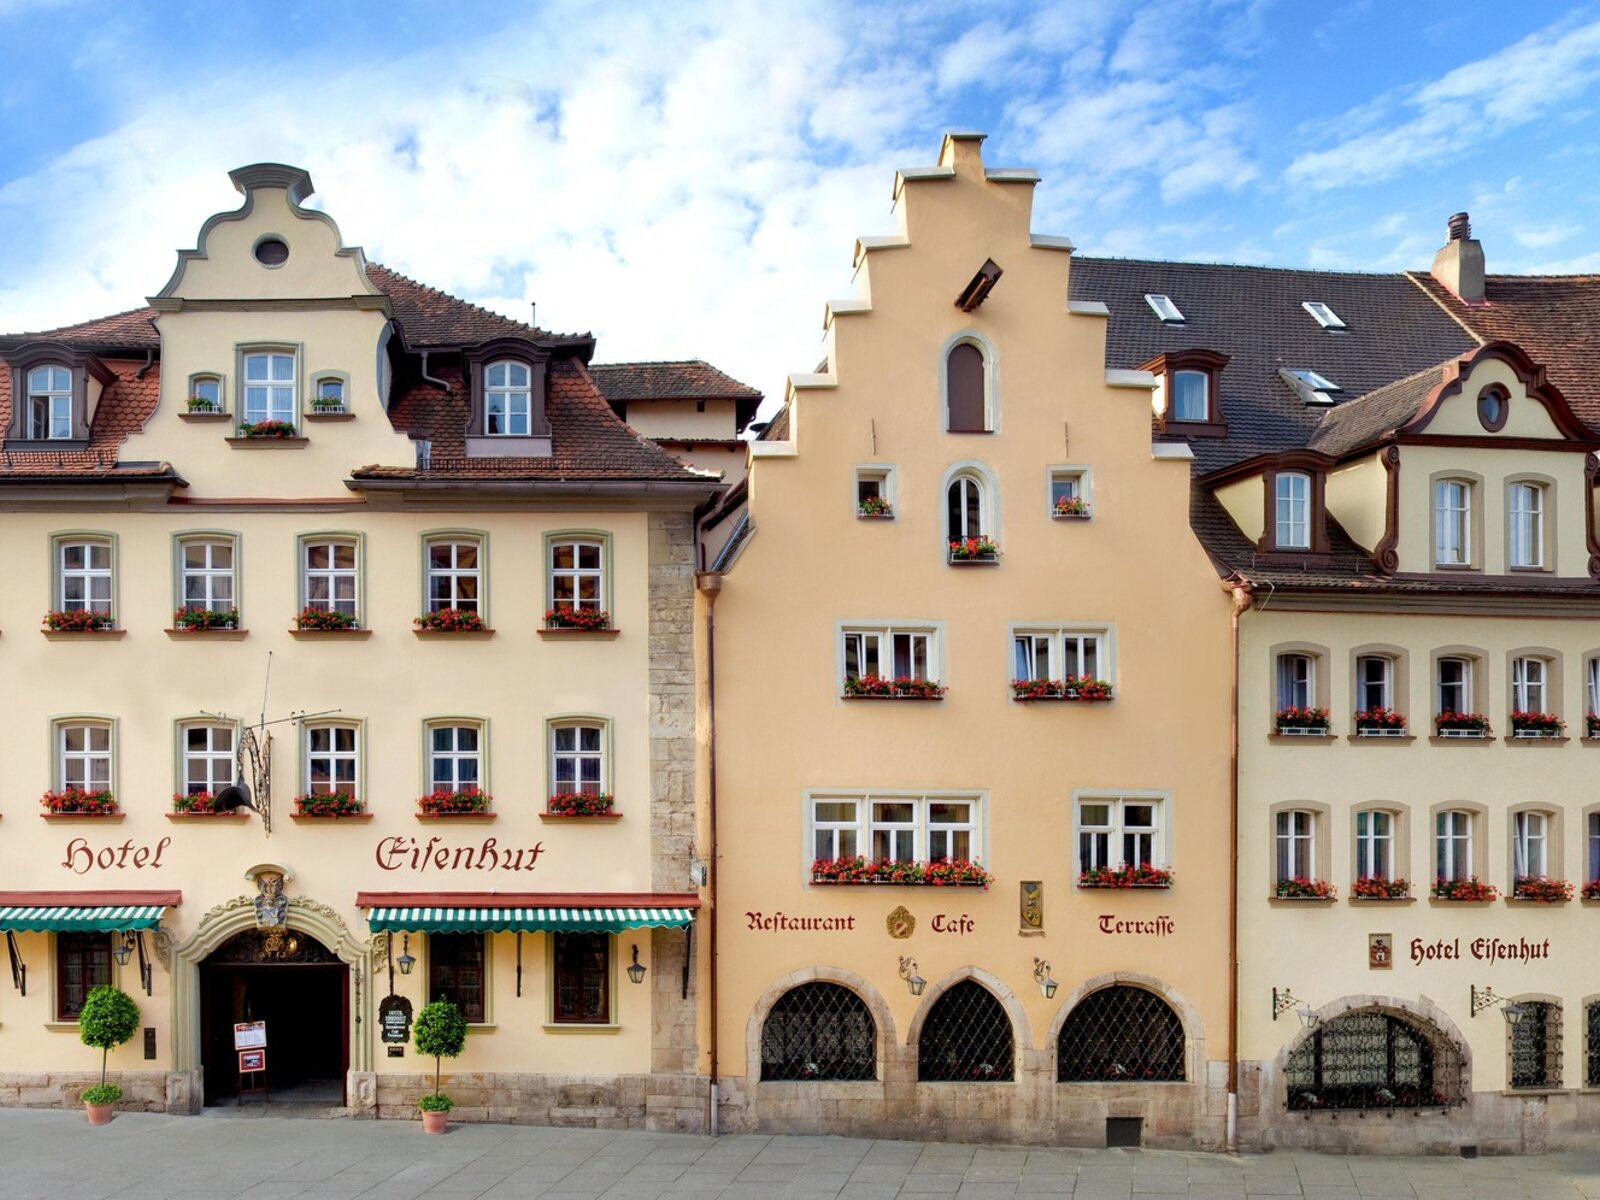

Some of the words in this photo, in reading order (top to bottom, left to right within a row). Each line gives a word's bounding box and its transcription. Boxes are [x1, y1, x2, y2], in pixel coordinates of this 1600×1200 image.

[61, 836, 172, 875] Hotel
[931, 913, 975, 936] Cafe
[1410, 937, 1460, 967] Hotel
